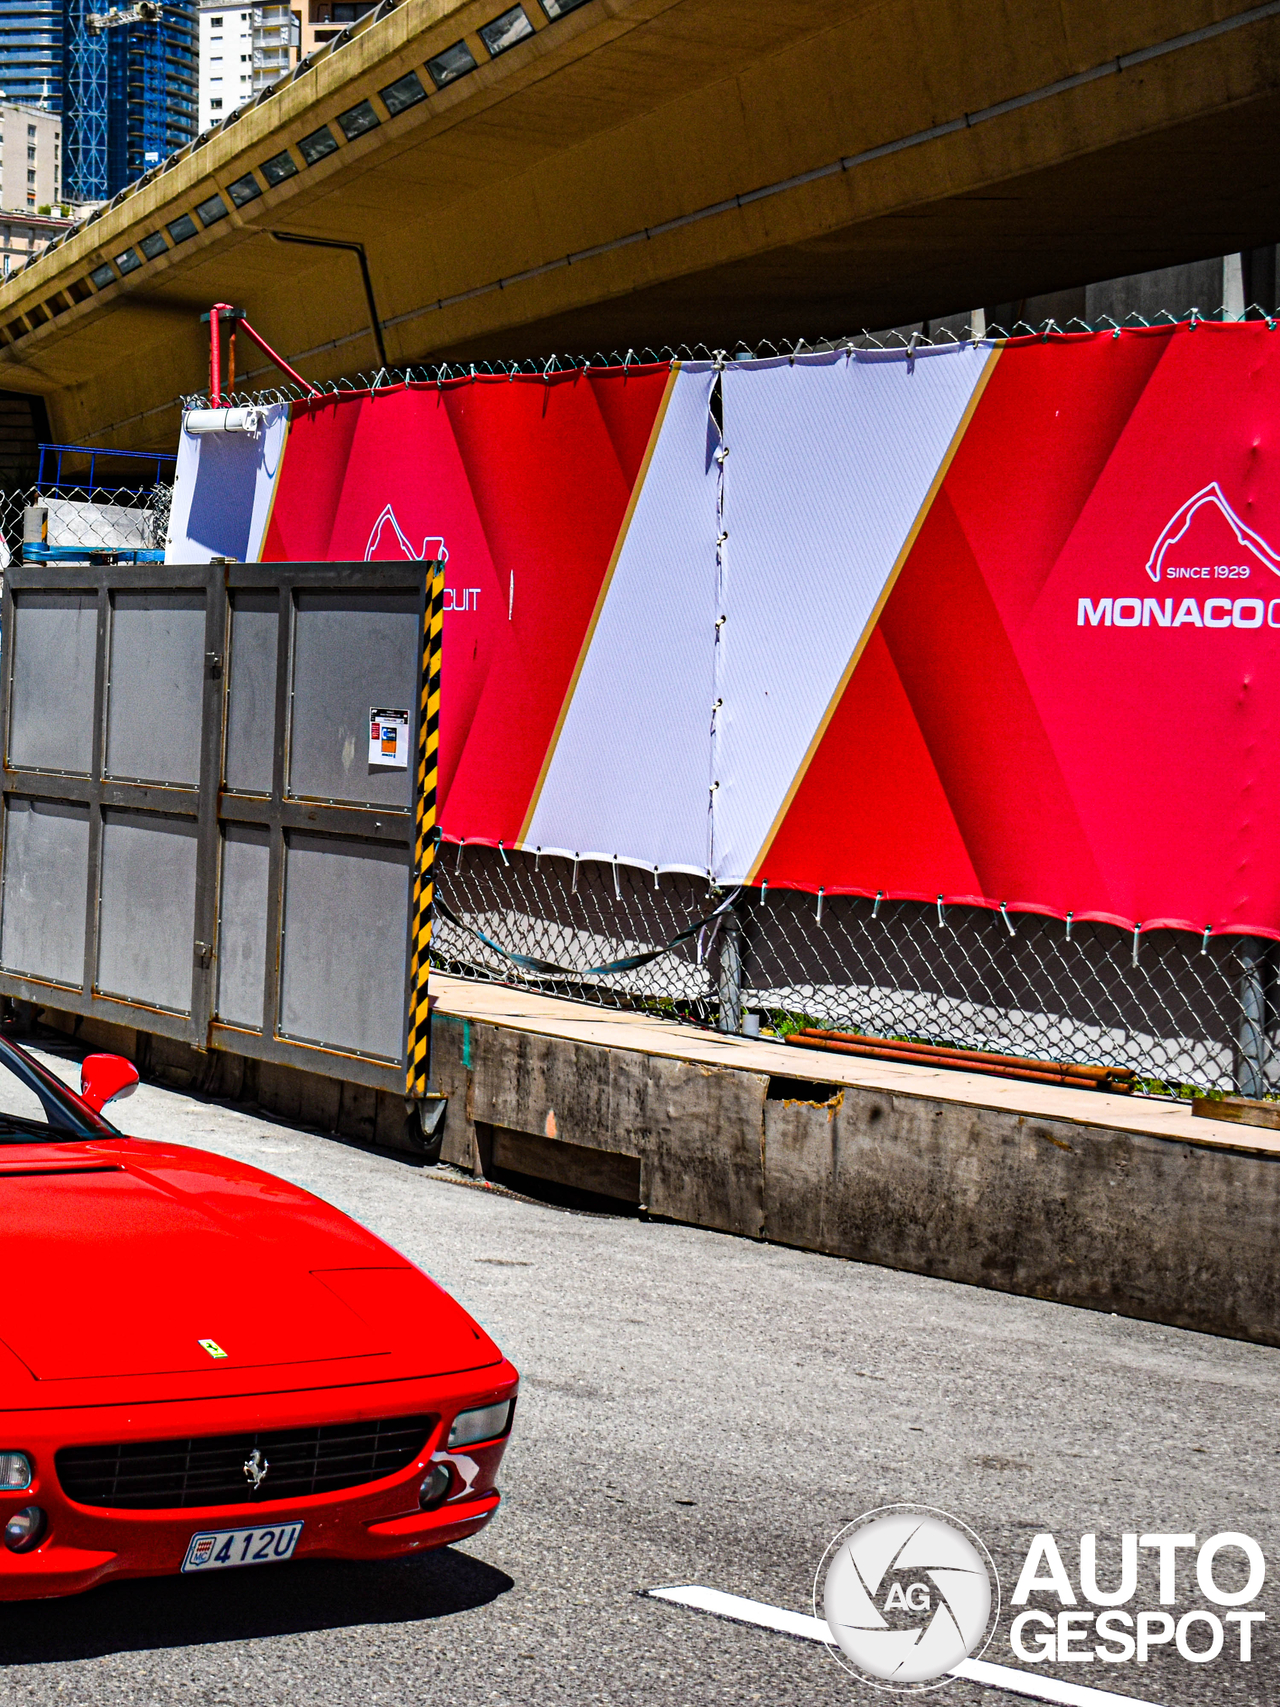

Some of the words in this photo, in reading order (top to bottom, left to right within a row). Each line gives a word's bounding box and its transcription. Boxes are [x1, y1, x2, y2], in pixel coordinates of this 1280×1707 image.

[1166, 567, 1211, 579] SINCE
[1214, 566, 1251, 579] 1929
[213, 1527, 297, 1563] 412U
